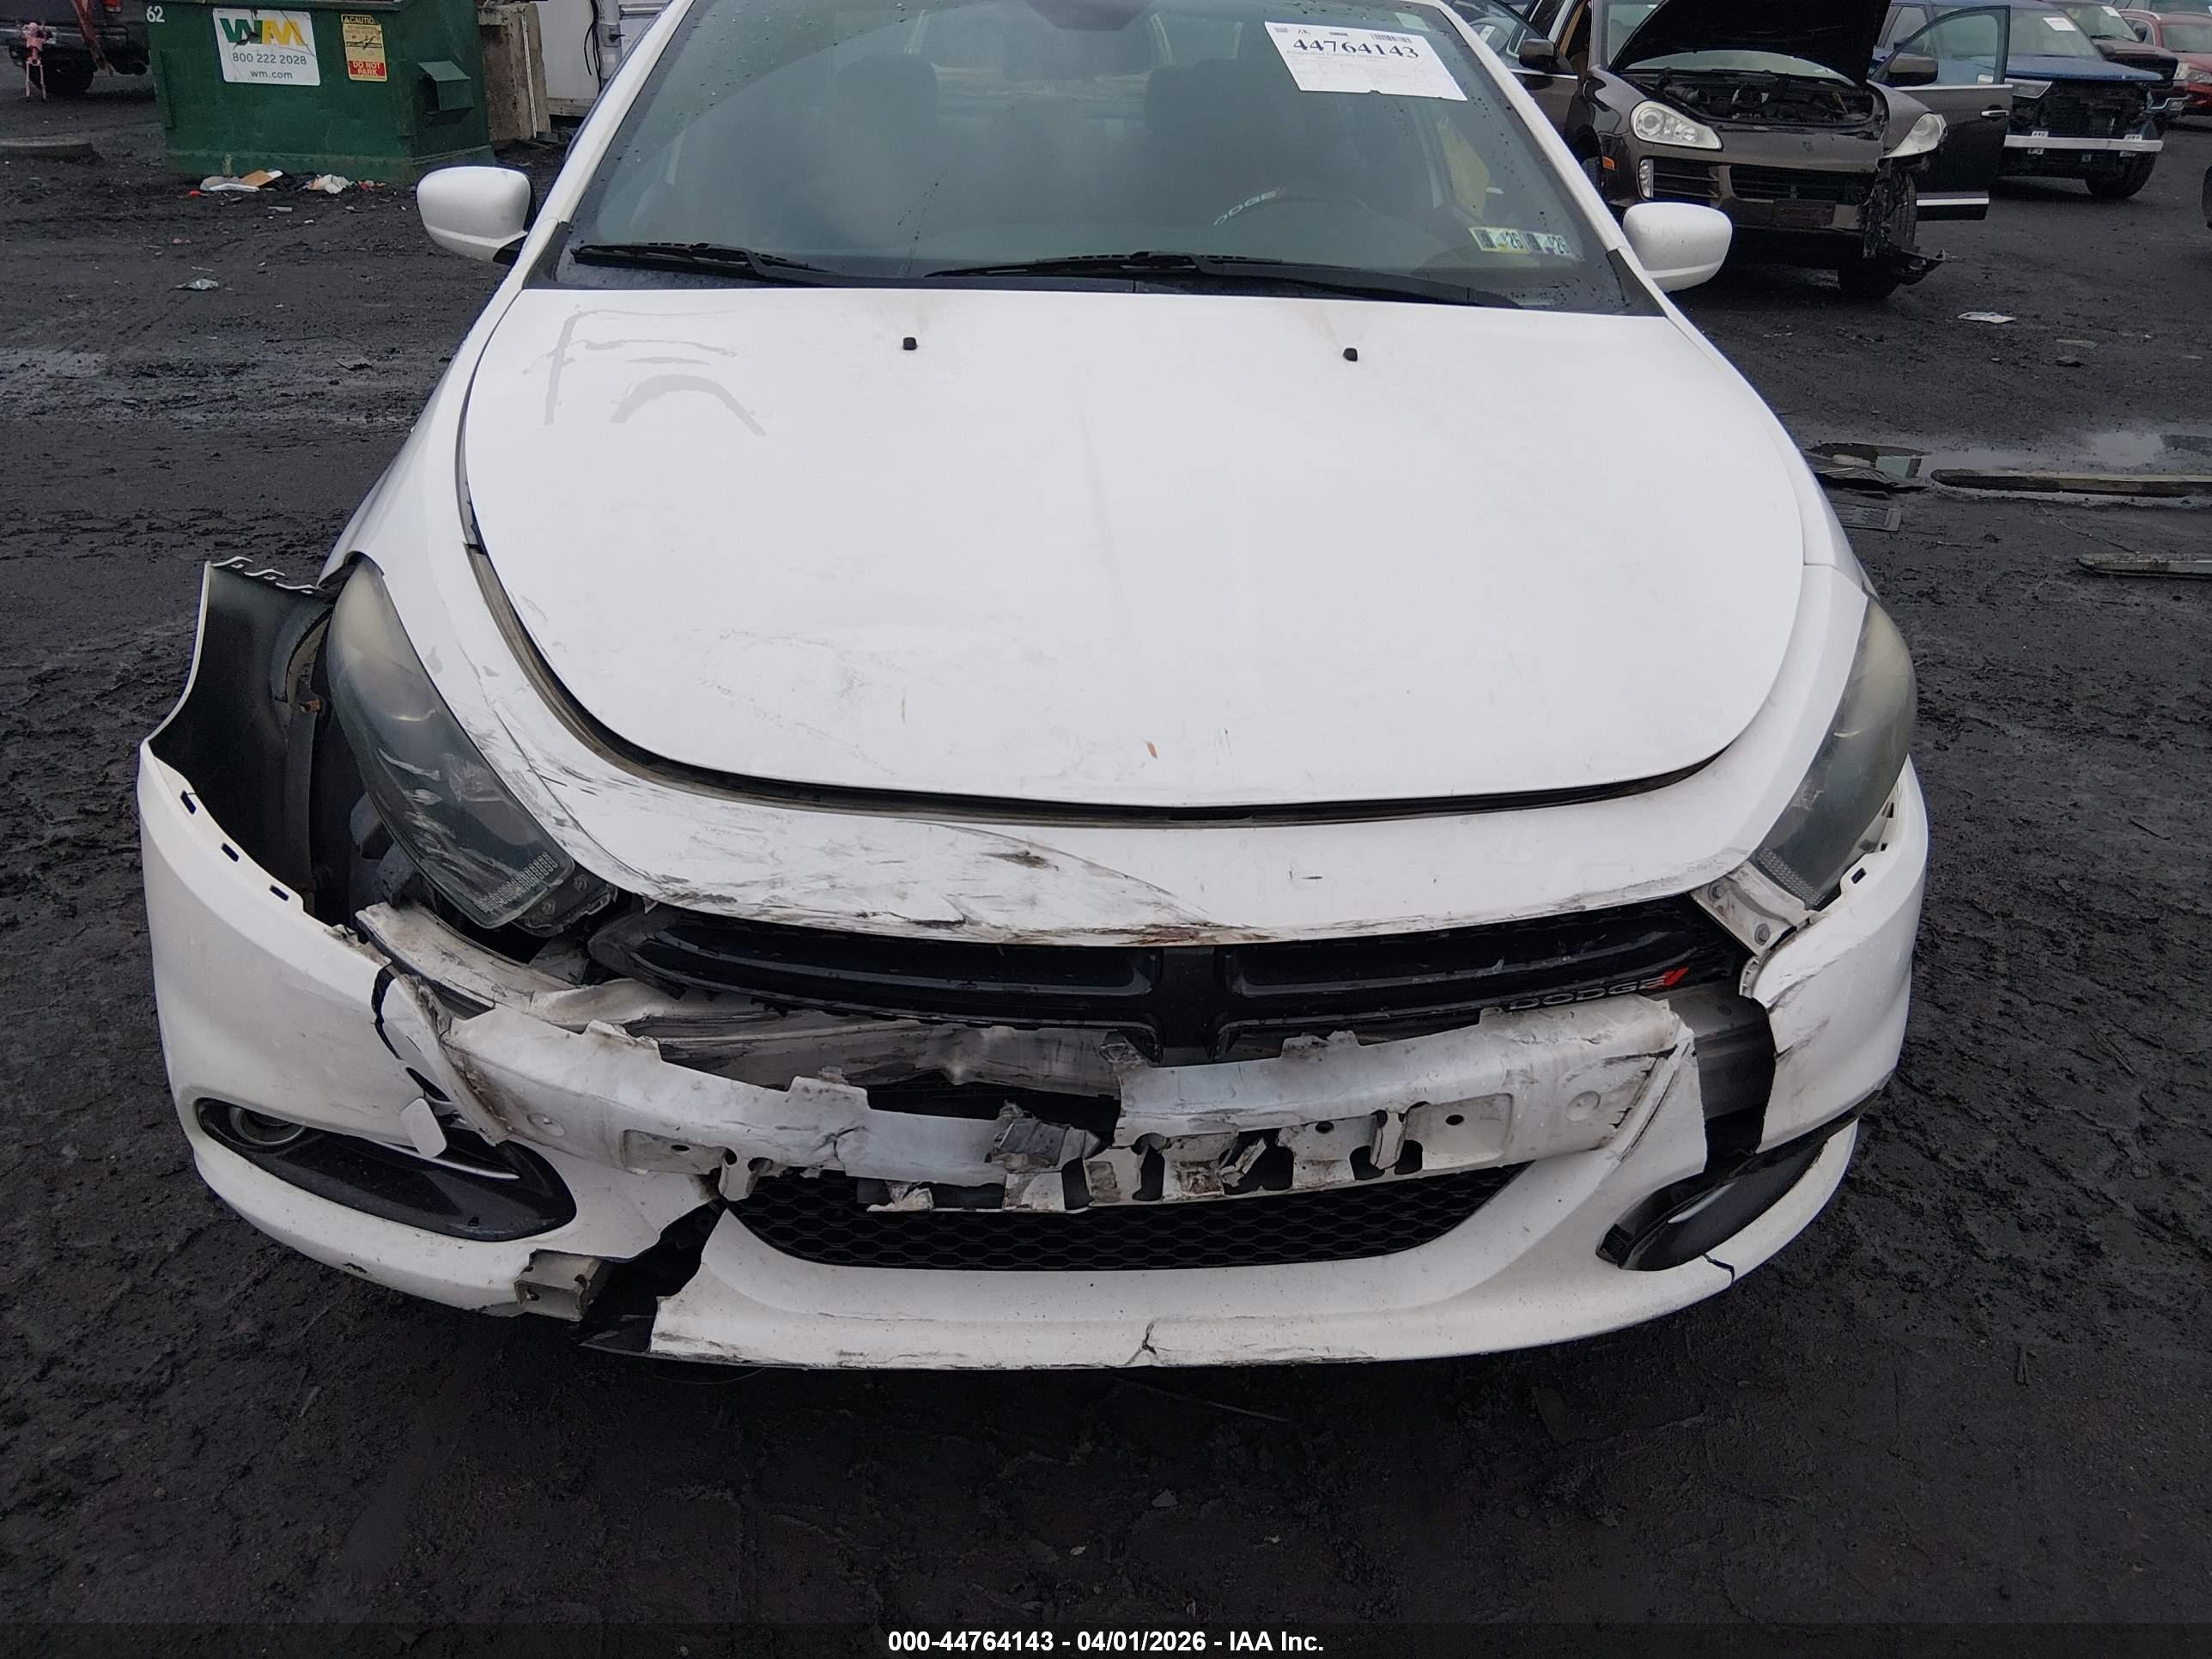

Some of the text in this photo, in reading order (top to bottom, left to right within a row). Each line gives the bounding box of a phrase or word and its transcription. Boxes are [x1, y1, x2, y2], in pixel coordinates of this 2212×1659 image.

[146, 5, 166, 23] 62
[349, 15, 377, 27] CAUTIO
[219, 18, 304, 46] WM
[1292, 39, 1419, 59] 44764143
[232, 52, 307, 66] 800 222 2028
[352, 61, 381, 70] DO NOT
[250, 69, 294, 81] wm.com
[357, 68, 378, 76] PARK
[1508, 975, 1667, 1010] DODGE
